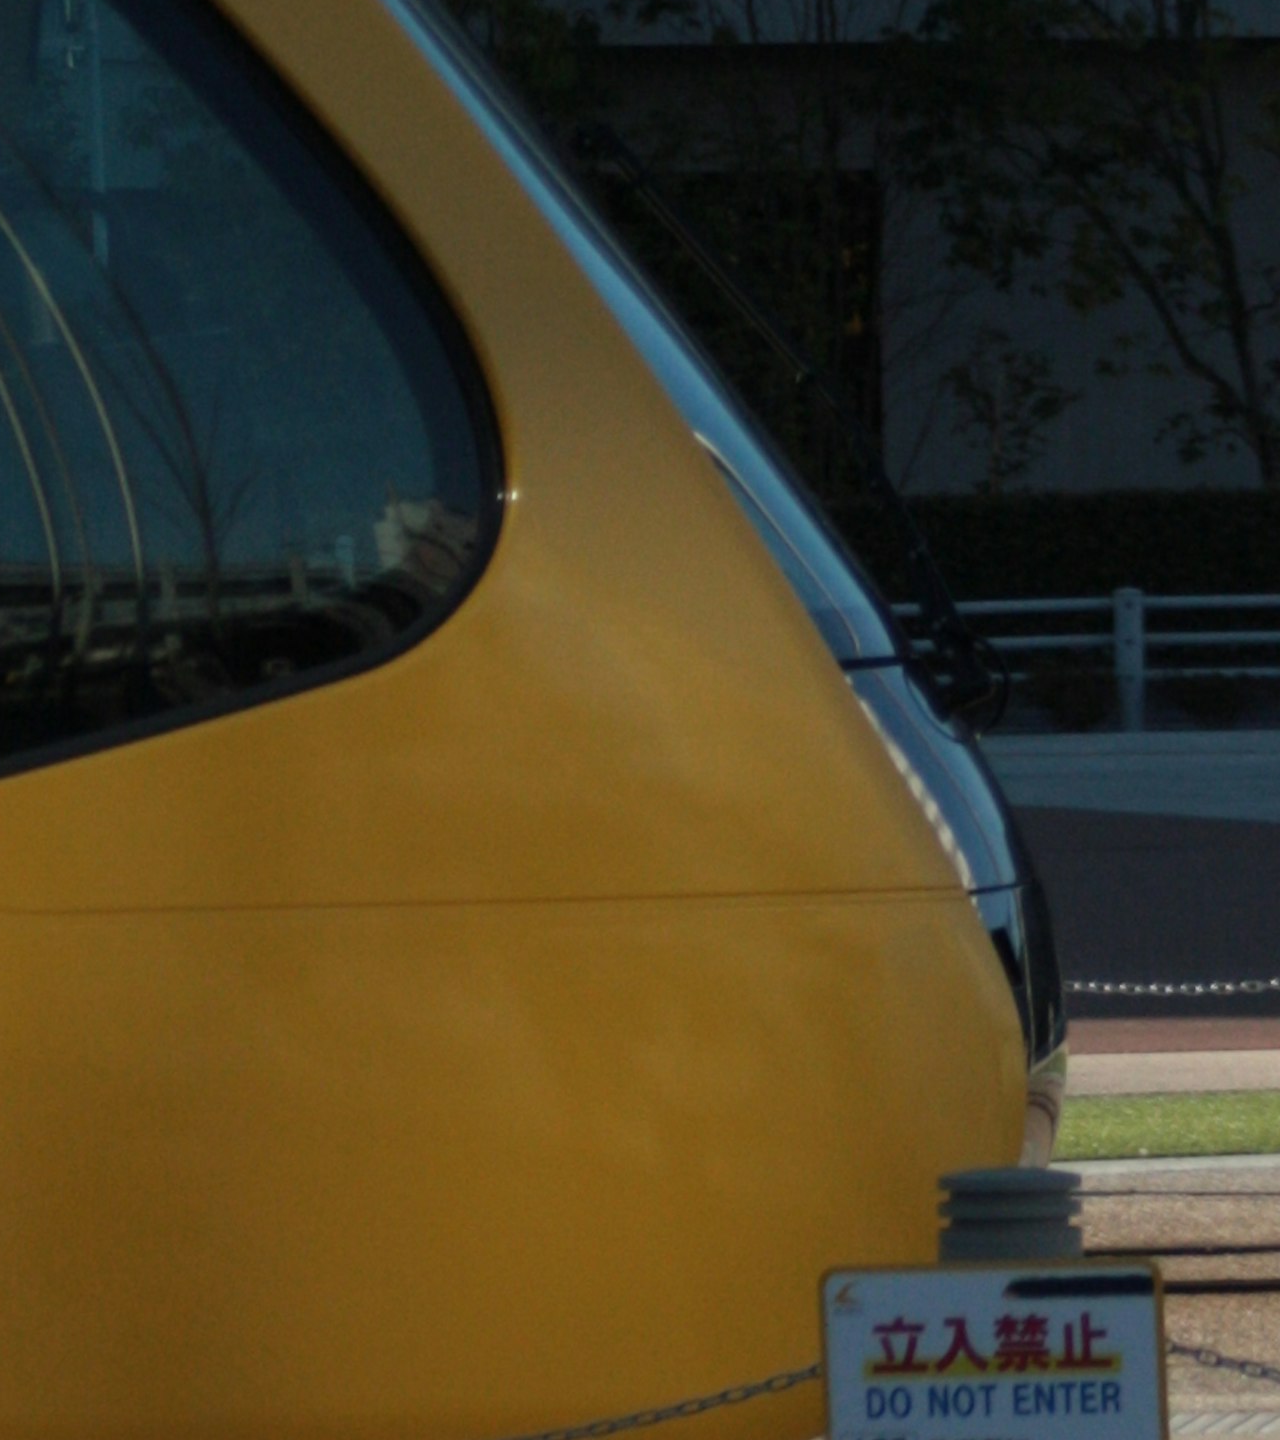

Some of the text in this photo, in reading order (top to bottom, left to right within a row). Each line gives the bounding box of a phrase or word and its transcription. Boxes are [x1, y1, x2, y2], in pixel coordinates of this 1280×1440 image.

[871, 1312, 1113, 1375] 立入禁止
[866, 1381, 1122, 1419] DO NOT ENTER
